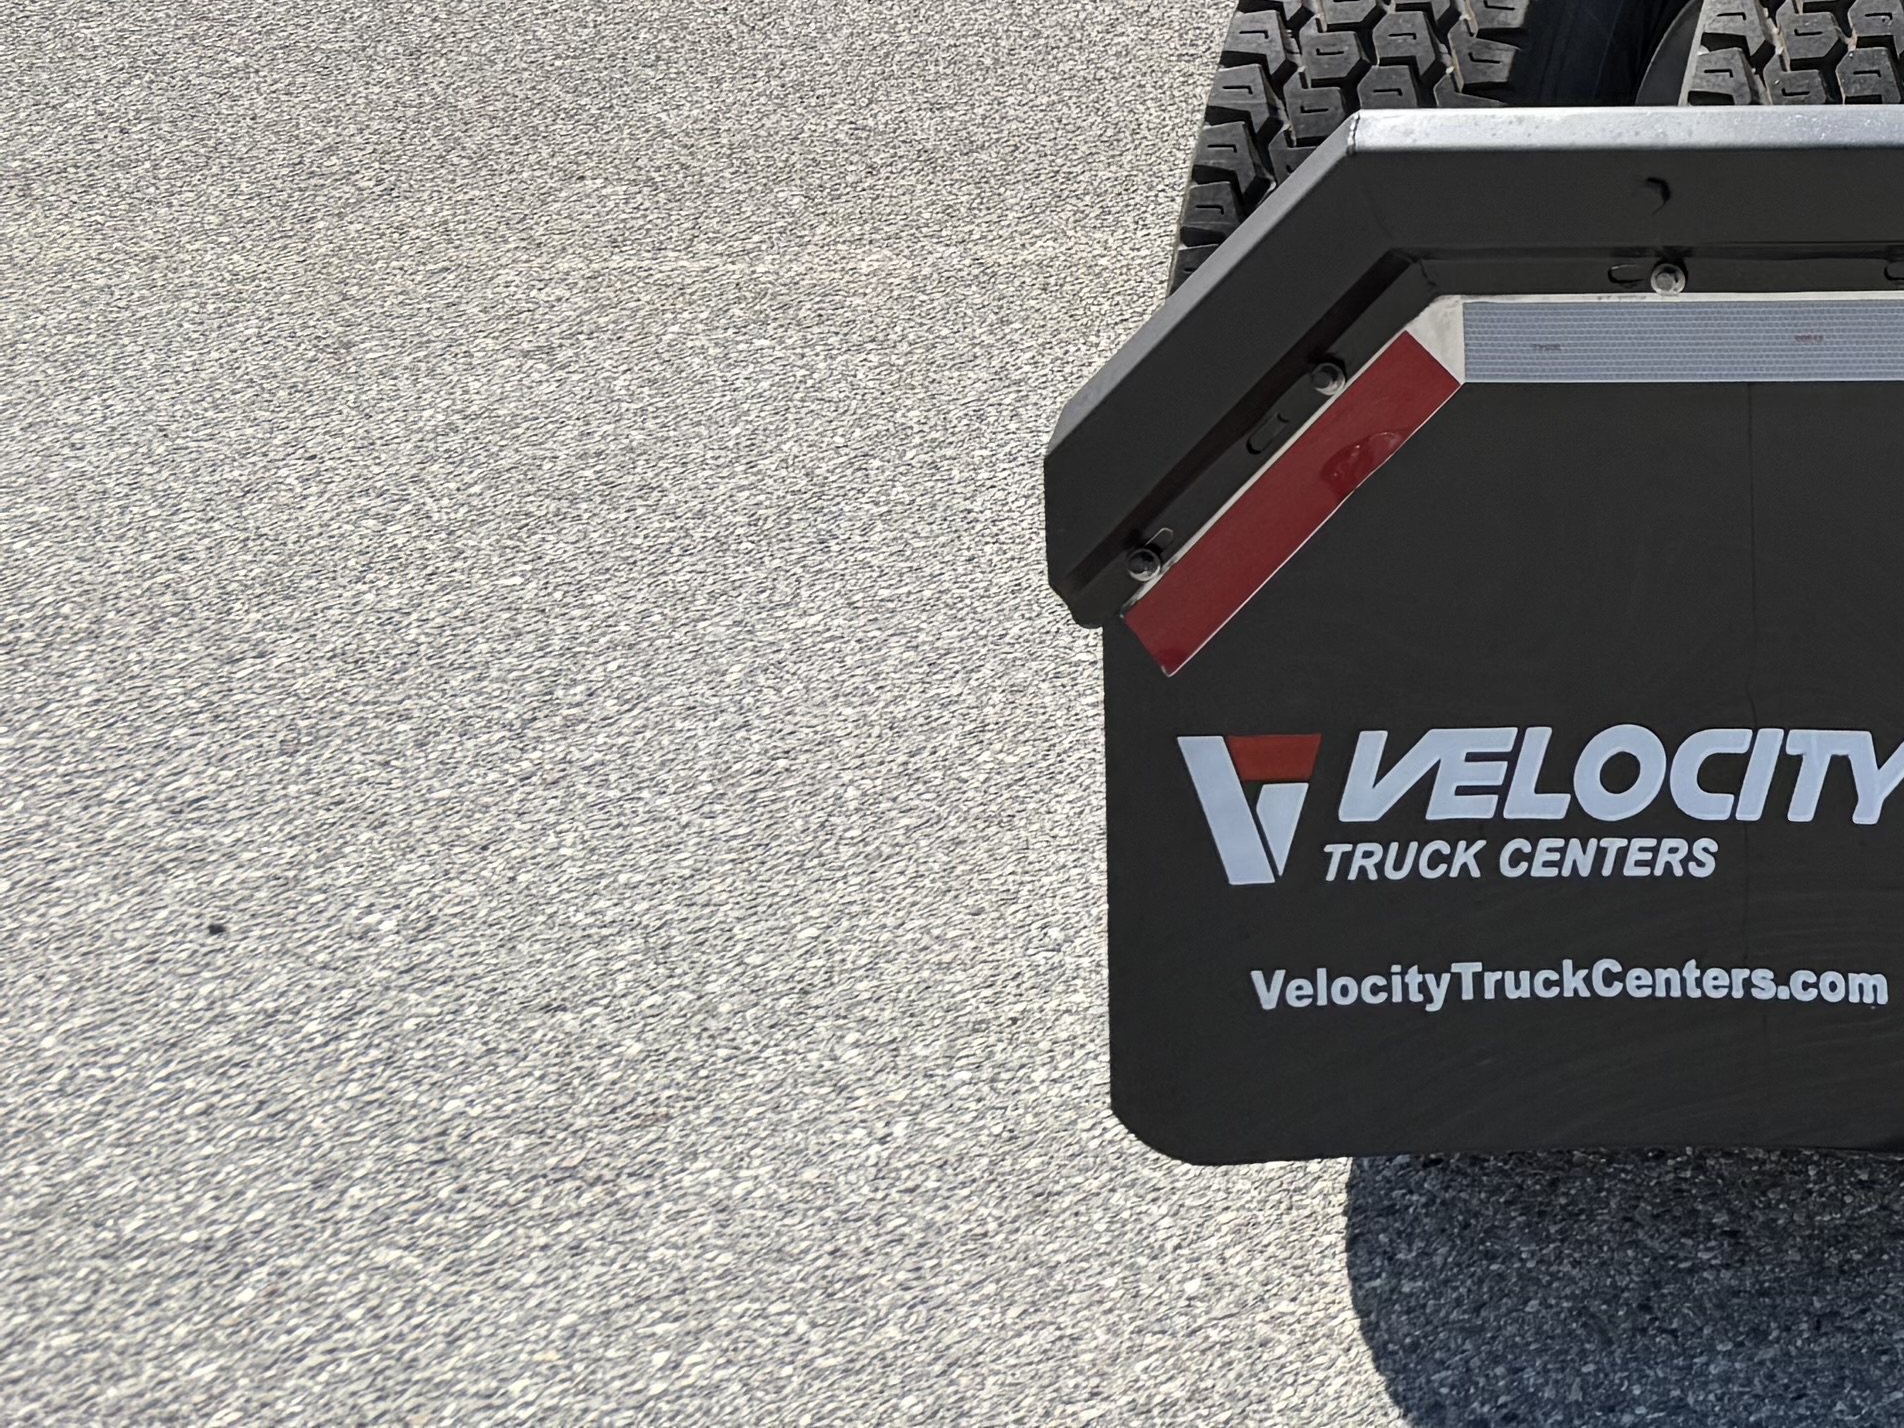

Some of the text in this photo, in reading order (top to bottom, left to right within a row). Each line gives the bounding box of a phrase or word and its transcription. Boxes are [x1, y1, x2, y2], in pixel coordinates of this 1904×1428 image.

[1323, 837, 1719, 882] TRUCK CENTERS
[1250, 958, 1890, 1013] VelocityTruckCenters.com
